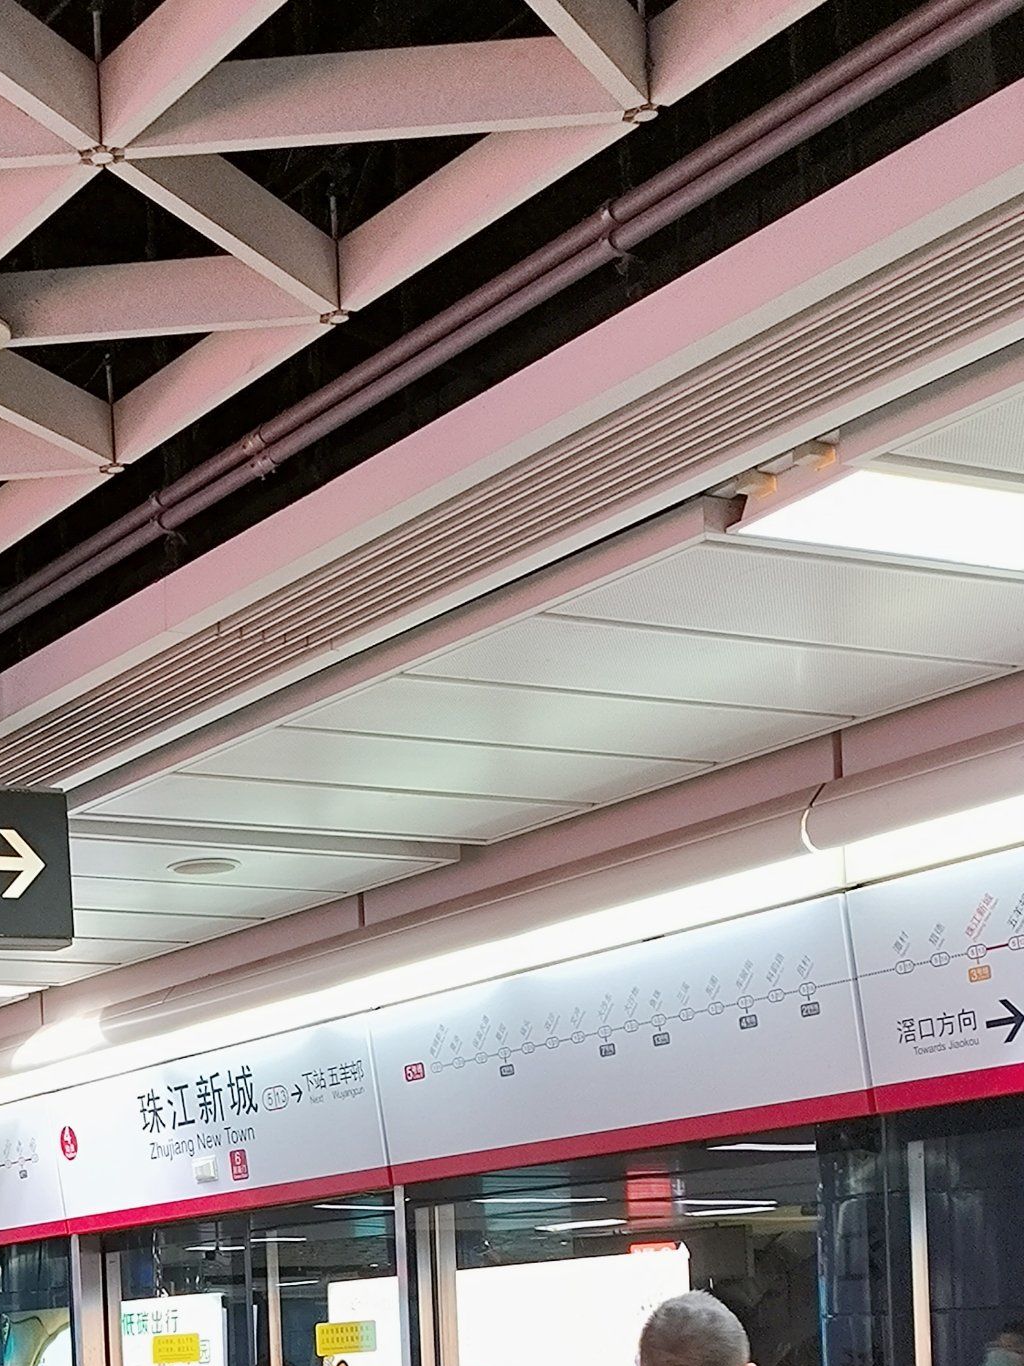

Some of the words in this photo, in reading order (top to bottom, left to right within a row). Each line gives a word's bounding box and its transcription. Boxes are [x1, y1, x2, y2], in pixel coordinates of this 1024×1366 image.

[897, 1008, 977, 1044] 滘口方向
[913, 1043, 946, 1056] Towards
[949, 1037, 979, 1052] Jiaokou
[301, 1068, 326, 1092] 下站
[137, 1065, 258, 1133] 珠江新城
[149, 1138, 195, 1160] Zhujiang
[197, 1133, 221, 1149] New
[224, 1126, 255, 1145] Town
